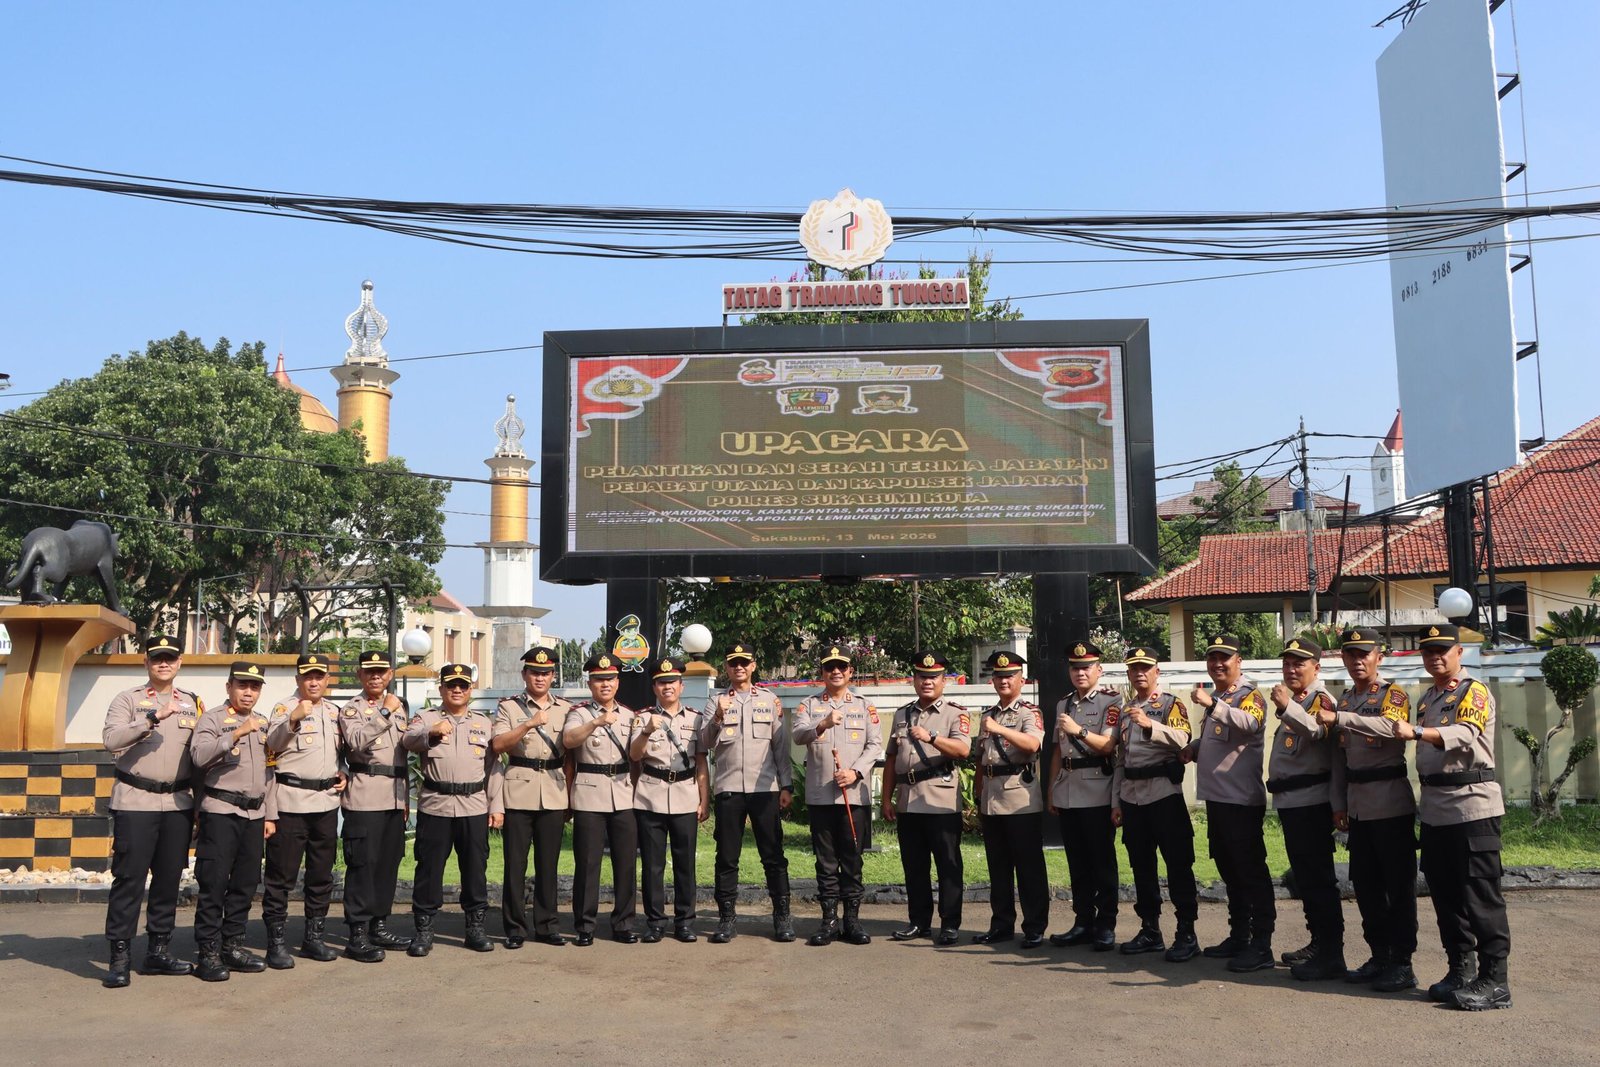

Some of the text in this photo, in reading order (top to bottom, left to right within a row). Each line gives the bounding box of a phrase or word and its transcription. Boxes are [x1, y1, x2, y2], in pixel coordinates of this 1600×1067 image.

[1401, 237, 1488, 302] 0813 2188 6834
[723, 281, 968, 309] TATAG TRAWANG TUNGGA
[720, 428, 969, 456] UPACARA
[584, 458, 1108, 478] PELANTIKAN DAN SERAH TERIMA JABATAN
[603, 474, 1089, 493] PEJABAT UTAMA DAN KAPOLSEK JAJARAN
[707, 492, 989, 507] POLRES SUKABUMI KOTA
[757, 507, 851, 515] KASATLANTAS,
[856, 506, 958, 514] KASATRESKRIM,
[751, 534, 831, 543] Sukabumi,
